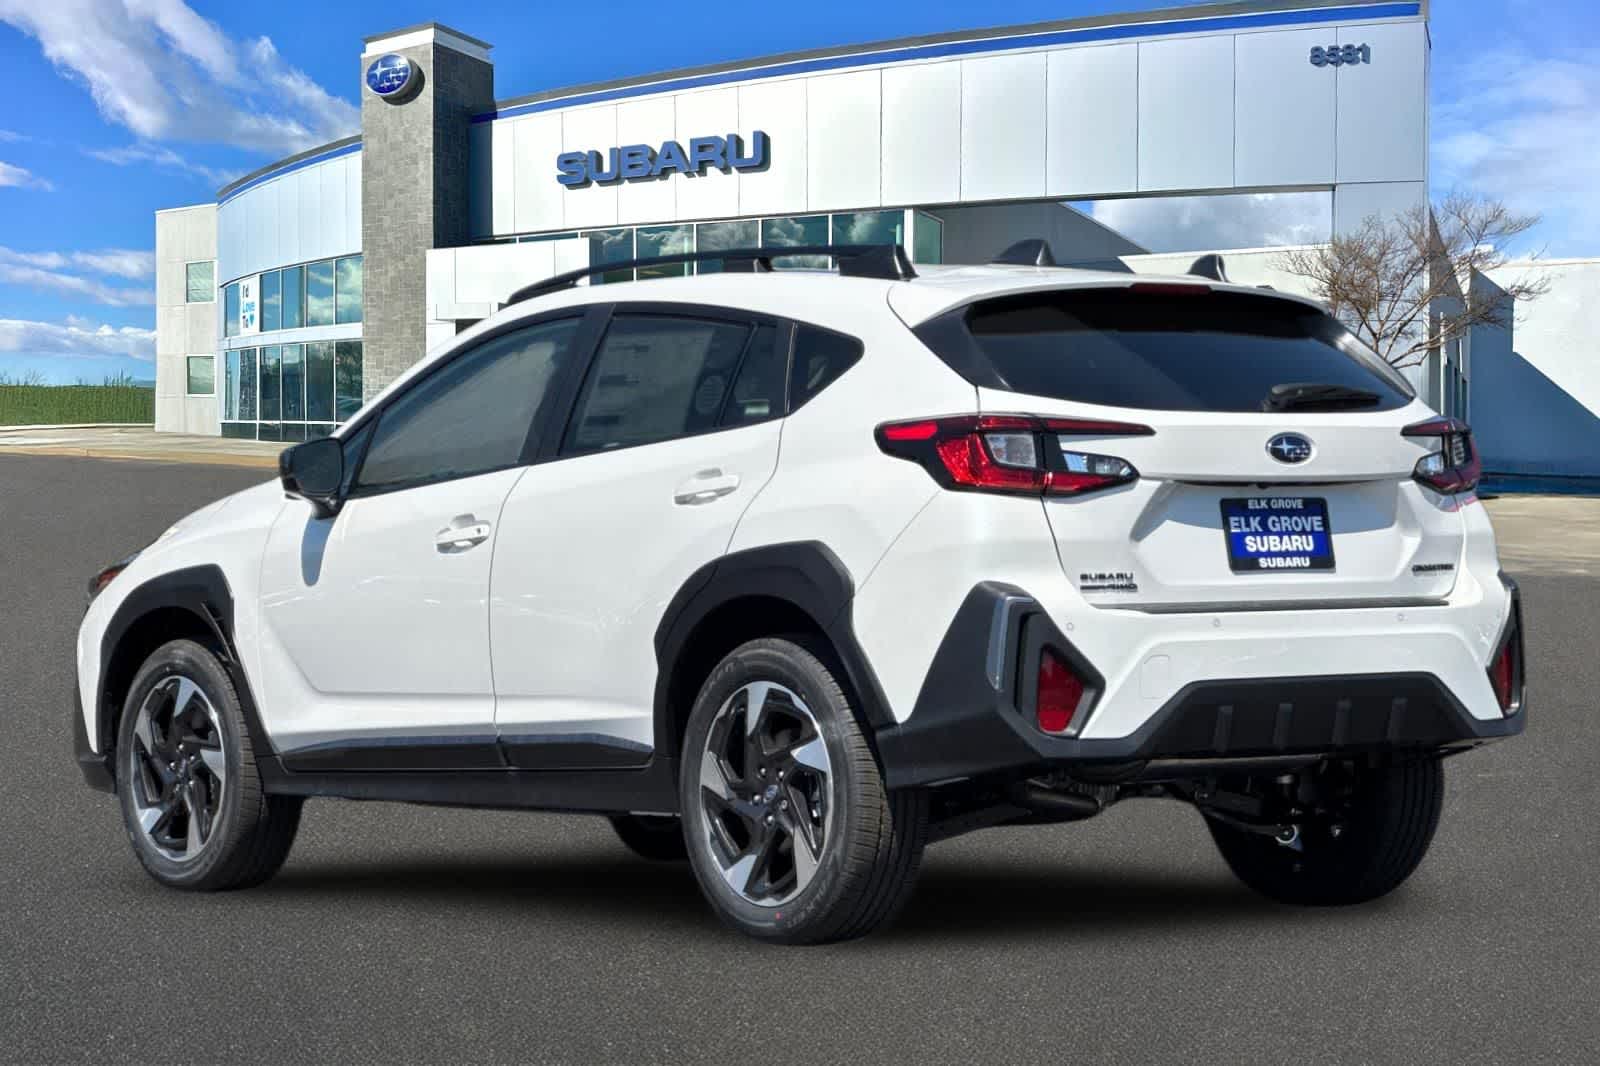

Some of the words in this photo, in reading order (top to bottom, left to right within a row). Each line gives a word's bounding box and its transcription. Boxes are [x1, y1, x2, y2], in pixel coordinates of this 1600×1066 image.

[556, 130, 769, 189] SUBARU
[1248, 499, 1268, 509] ELK
[1270, 499, 1304, 509] GROVE
[1229, 516, 1263, 532] ELK
[1268, 516, 1324, 532] GROVE
[1245, 535, 1314, 552] SUBARU
[1259, 557, 1310, 568] SUBARU
[1080, 572, 1134, 581] SUBARU
